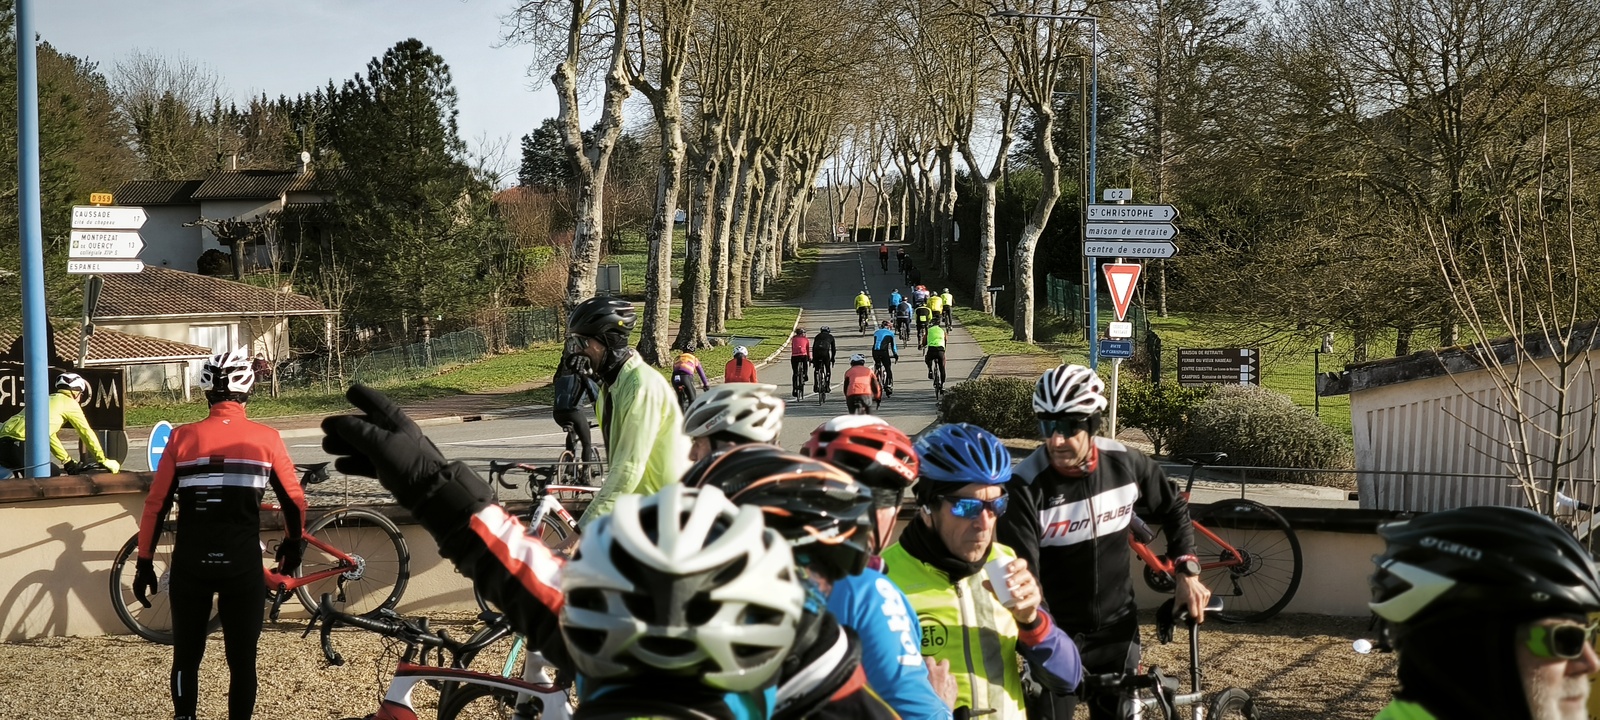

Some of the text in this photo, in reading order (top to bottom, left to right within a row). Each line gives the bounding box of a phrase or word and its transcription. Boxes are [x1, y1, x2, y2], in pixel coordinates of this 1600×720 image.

[1111, 191, 1116, 199] C
[1101, 208, 1153, 217] CHRISTOPHE
[1163, 209, 1169, 217] 3
[1088, 227, 1168, 236] maison de retraite
[1087, 246, 1114, 254] centre
[1118, 245, 1128, 254] de
[1437, 540, 1482, 560] GIRO
[920, 634, 945, 648] élo
